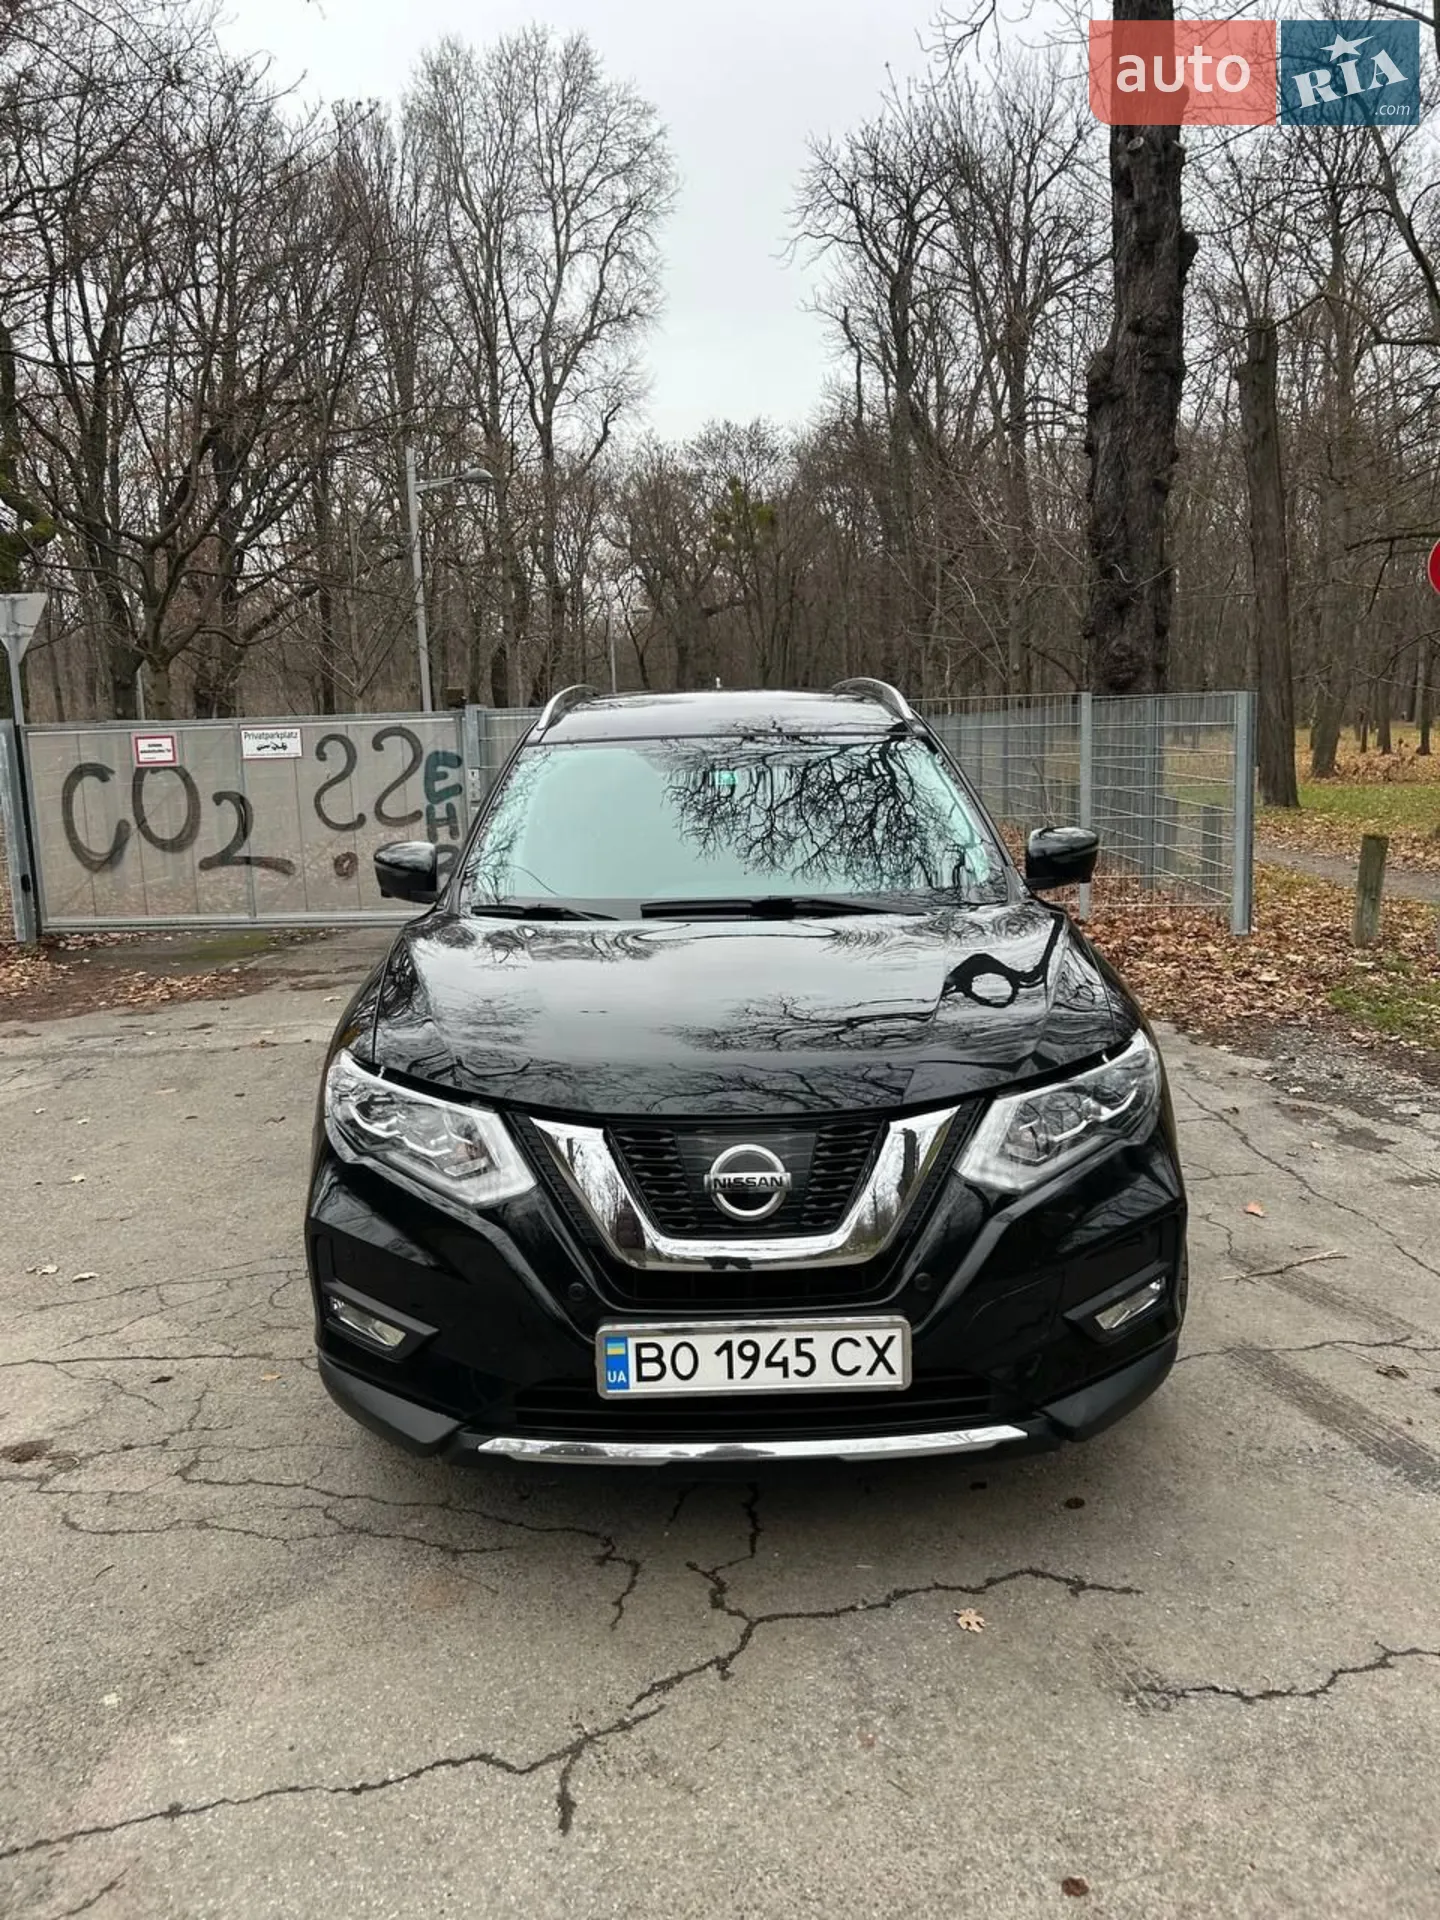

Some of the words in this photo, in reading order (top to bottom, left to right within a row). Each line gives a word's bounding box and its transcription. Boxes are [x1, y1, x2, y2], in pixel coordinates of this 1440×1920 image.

[244, 731, 298, 740] Privatparkplatz
[61, 762, 295, 876] CO2
[713, 1176, 784, 1189] NISSAN
[634, 1341, 699, 1383] BO
[714, 1337, 817, 1380] 1945
[831, 1335, 897, 1377] CX
[607, 1370, 627, 1384] UA
